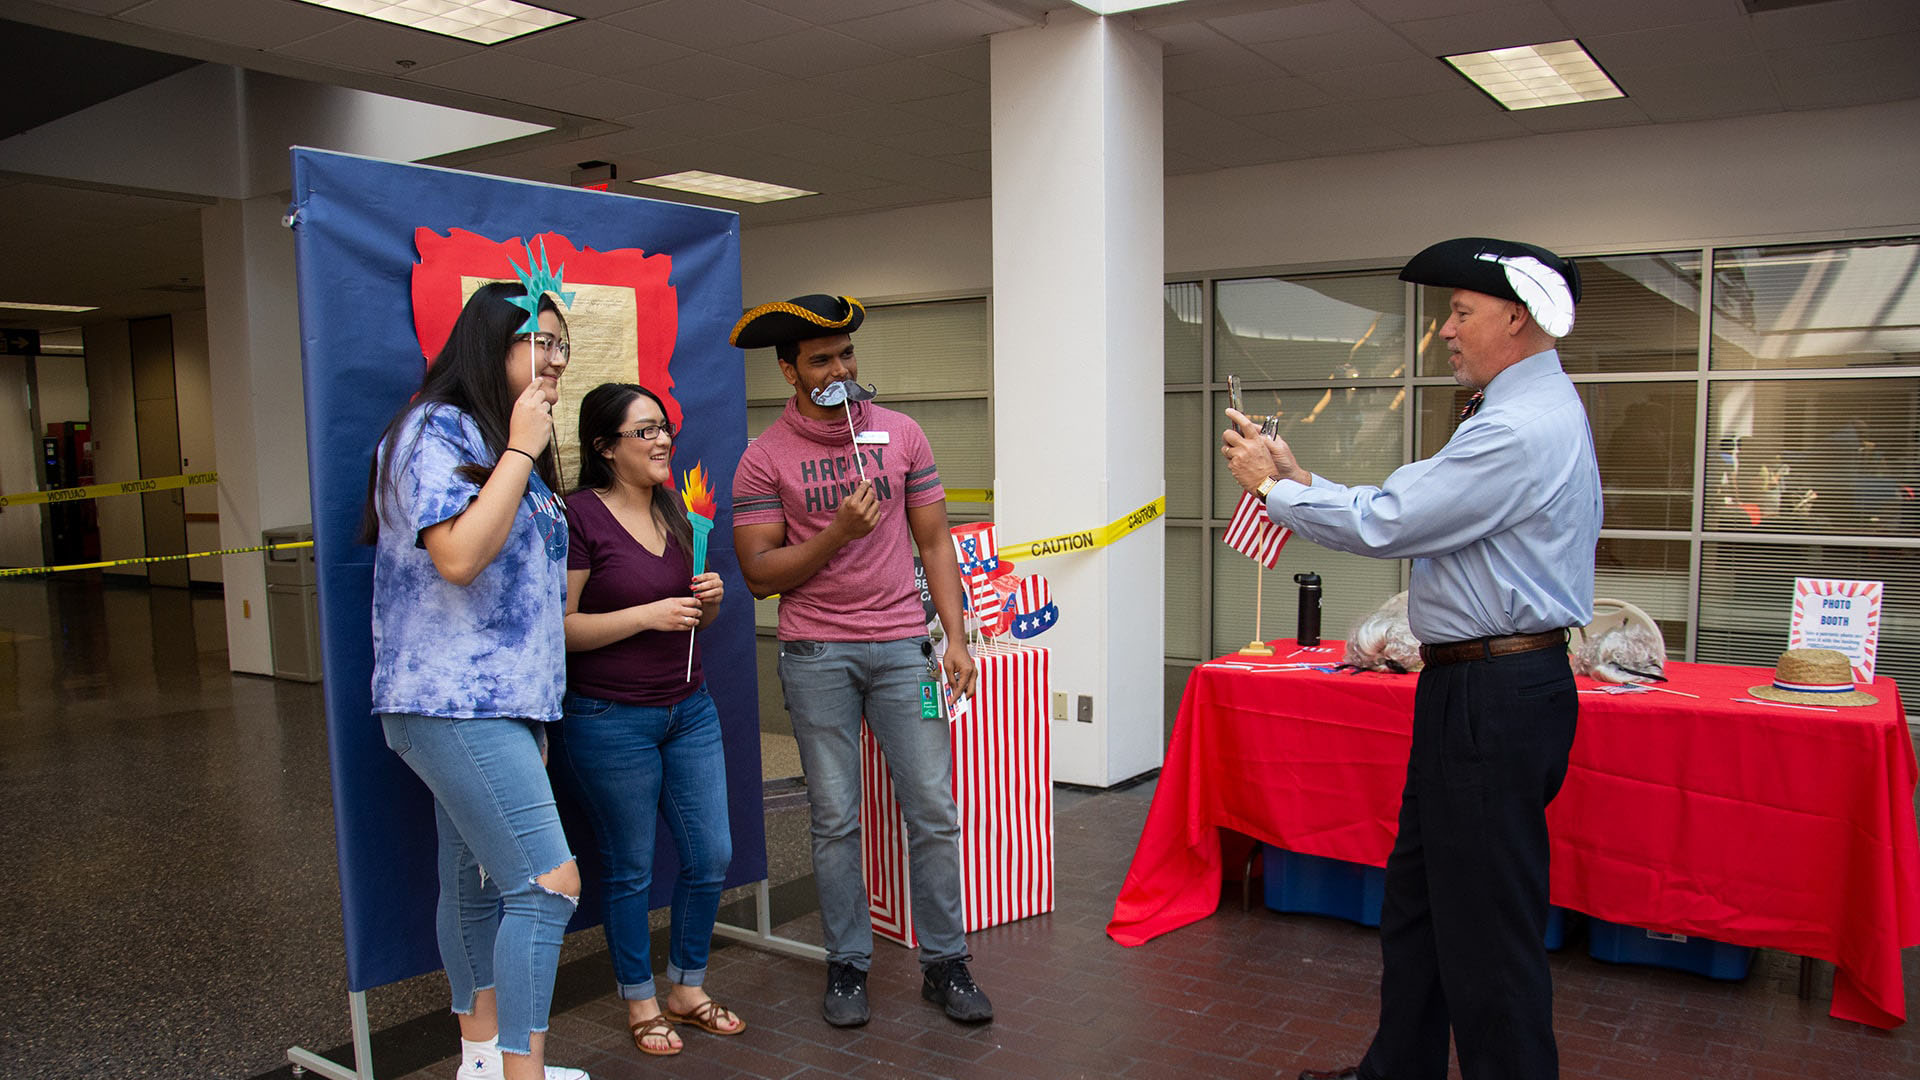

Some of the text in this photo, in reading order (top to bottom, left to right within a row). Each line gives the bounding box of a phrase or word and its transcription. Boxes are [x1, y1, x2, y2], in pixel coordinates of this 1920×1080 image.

[801, 448, 884, 483] HAPPY
[805, 476, 892, 512] HUMN
[1128, 503, 1158, 529] CAUTION
[1031, 532, 1094, 557] CAUTION
[1823, 598, 1851, 609] PHOTO
[1821, 615, 1849, 626] BOOTH
